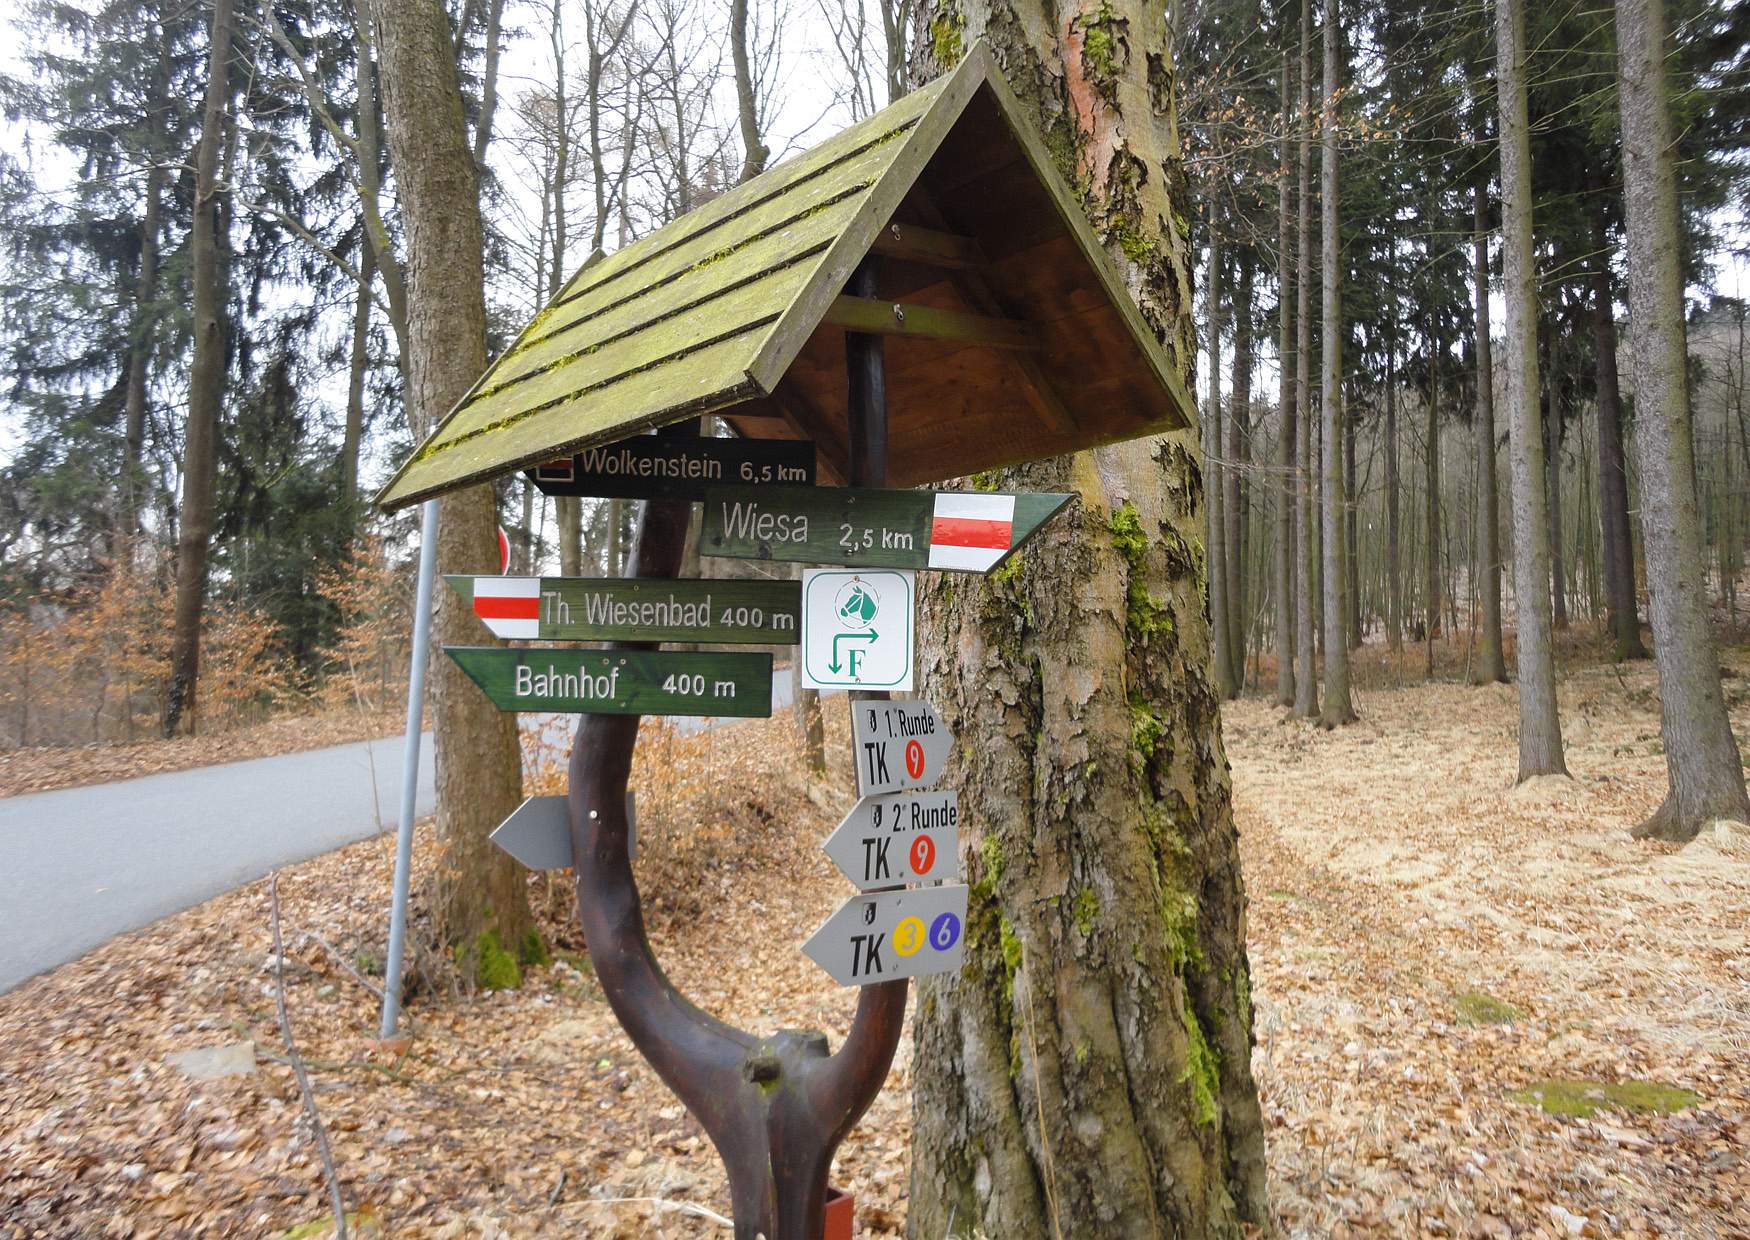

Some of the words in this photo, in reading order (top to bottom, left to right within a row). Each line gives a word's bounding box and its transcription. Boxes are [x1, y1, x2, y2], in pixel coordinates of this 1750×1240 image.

[581, 448, 722, 480] Wolkenstein
[740, 462, 772, 485] 6,5
[777, 464, 807, 482] km
[722, 502, 809, 543] Wiesa
[839, 523, 874, 550] 2,5
[881, 528, 914, 551] km
[541, 591, 576, 627] Th.
[585, 592, 712, 629] Wiesenbad
[720, 607, 764, 628] 400
[772, 612, 795, 630] m
[515, 665, 620, 699] Bahnhof
[662, 673, 706, 697] 400
[714, 682, 737, 698] m
[848, 649, 866, 677] F
[885, 710, 897, 738] 1.
[900, 709, 935, 737] Runde
[864, 742, 890, 785] TK
[910, 746, 919, 772] 9
[893, 803, 906, 832] 2.
[911, 801, 957, 829] Runde
[862, 837, 891, 881] TK
[917, 842, 928, 871] 9
[850, 933, 885, 977] TK
[901, 922, 916, 951] 3
[938, 917, 952, 946] 6
